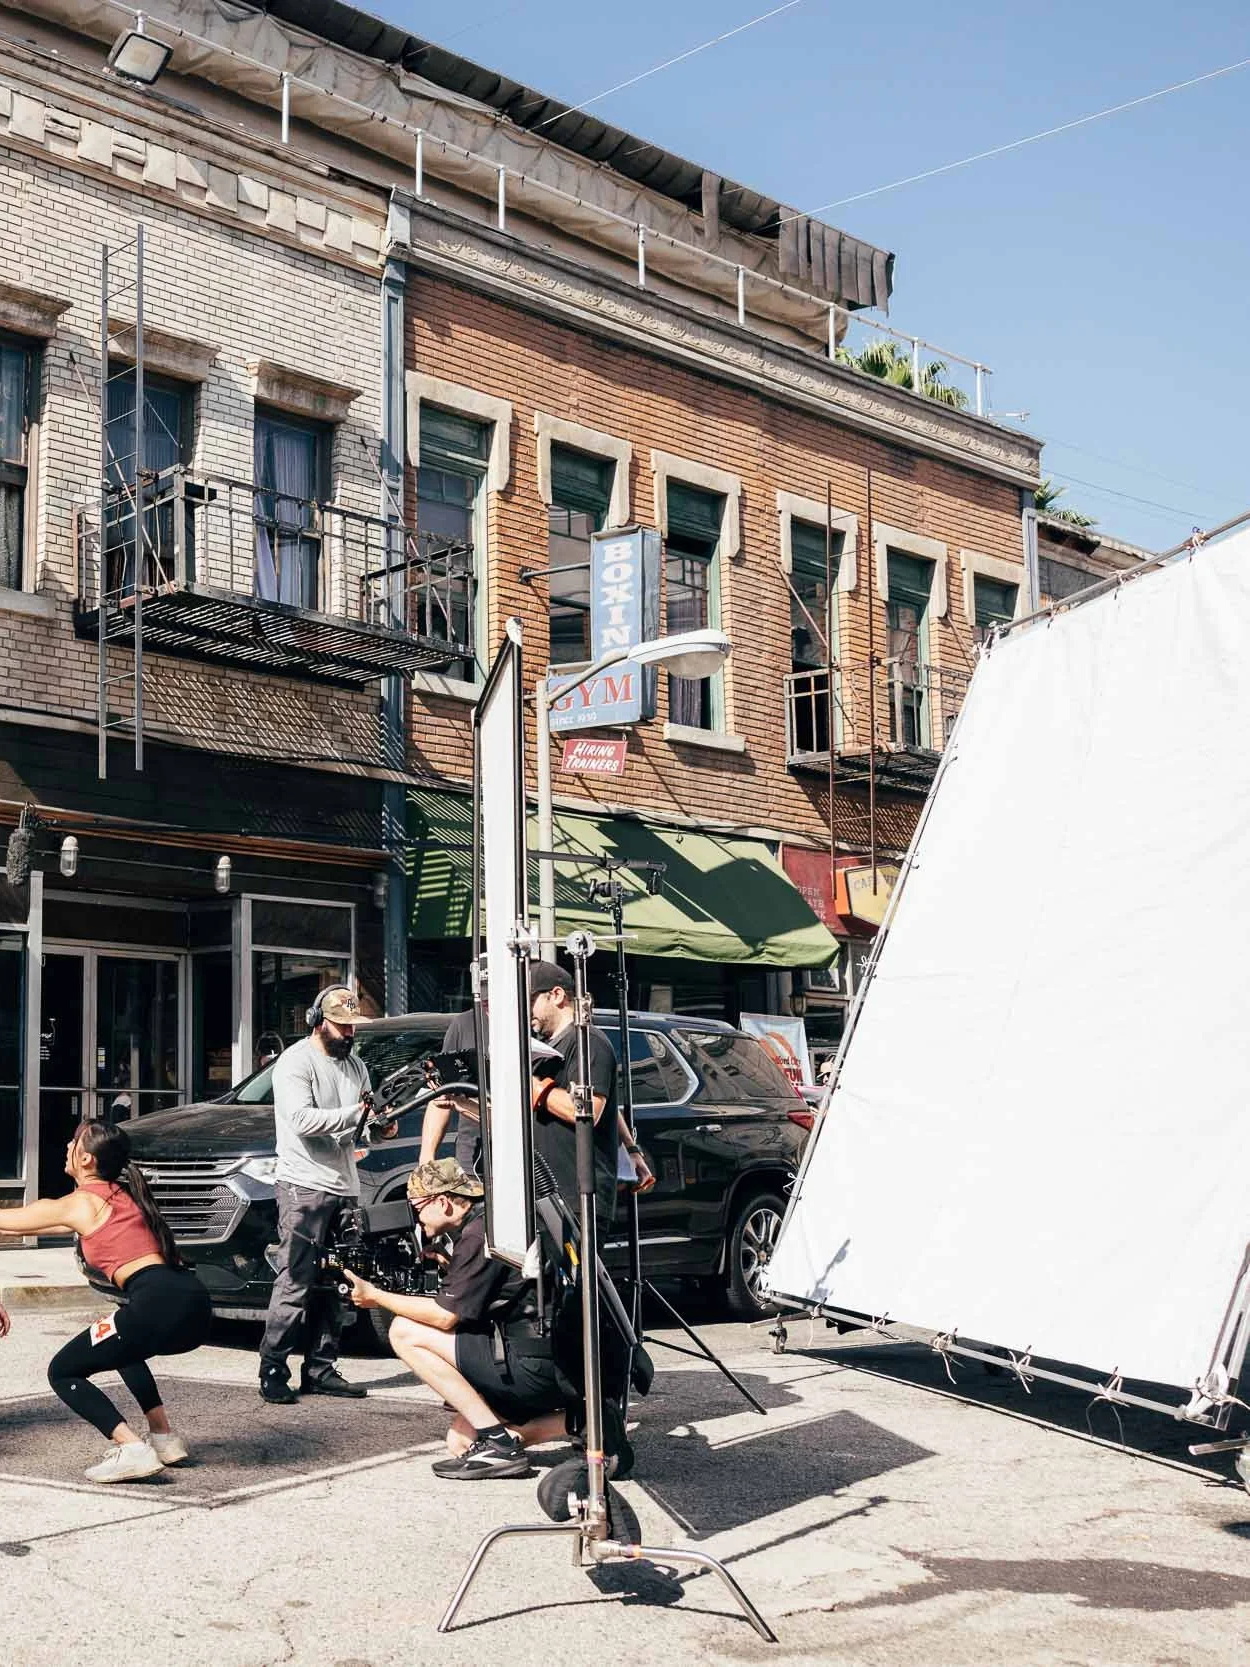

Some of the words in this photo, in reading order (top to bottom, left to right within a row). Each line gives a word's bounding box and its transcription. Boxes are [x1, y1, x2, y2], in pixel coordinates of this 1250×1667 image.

[551, 675, 635, 712] GYM
[573, 741, 616, 757] HIRING
[566, 754, 619, 772] TRAINERS
